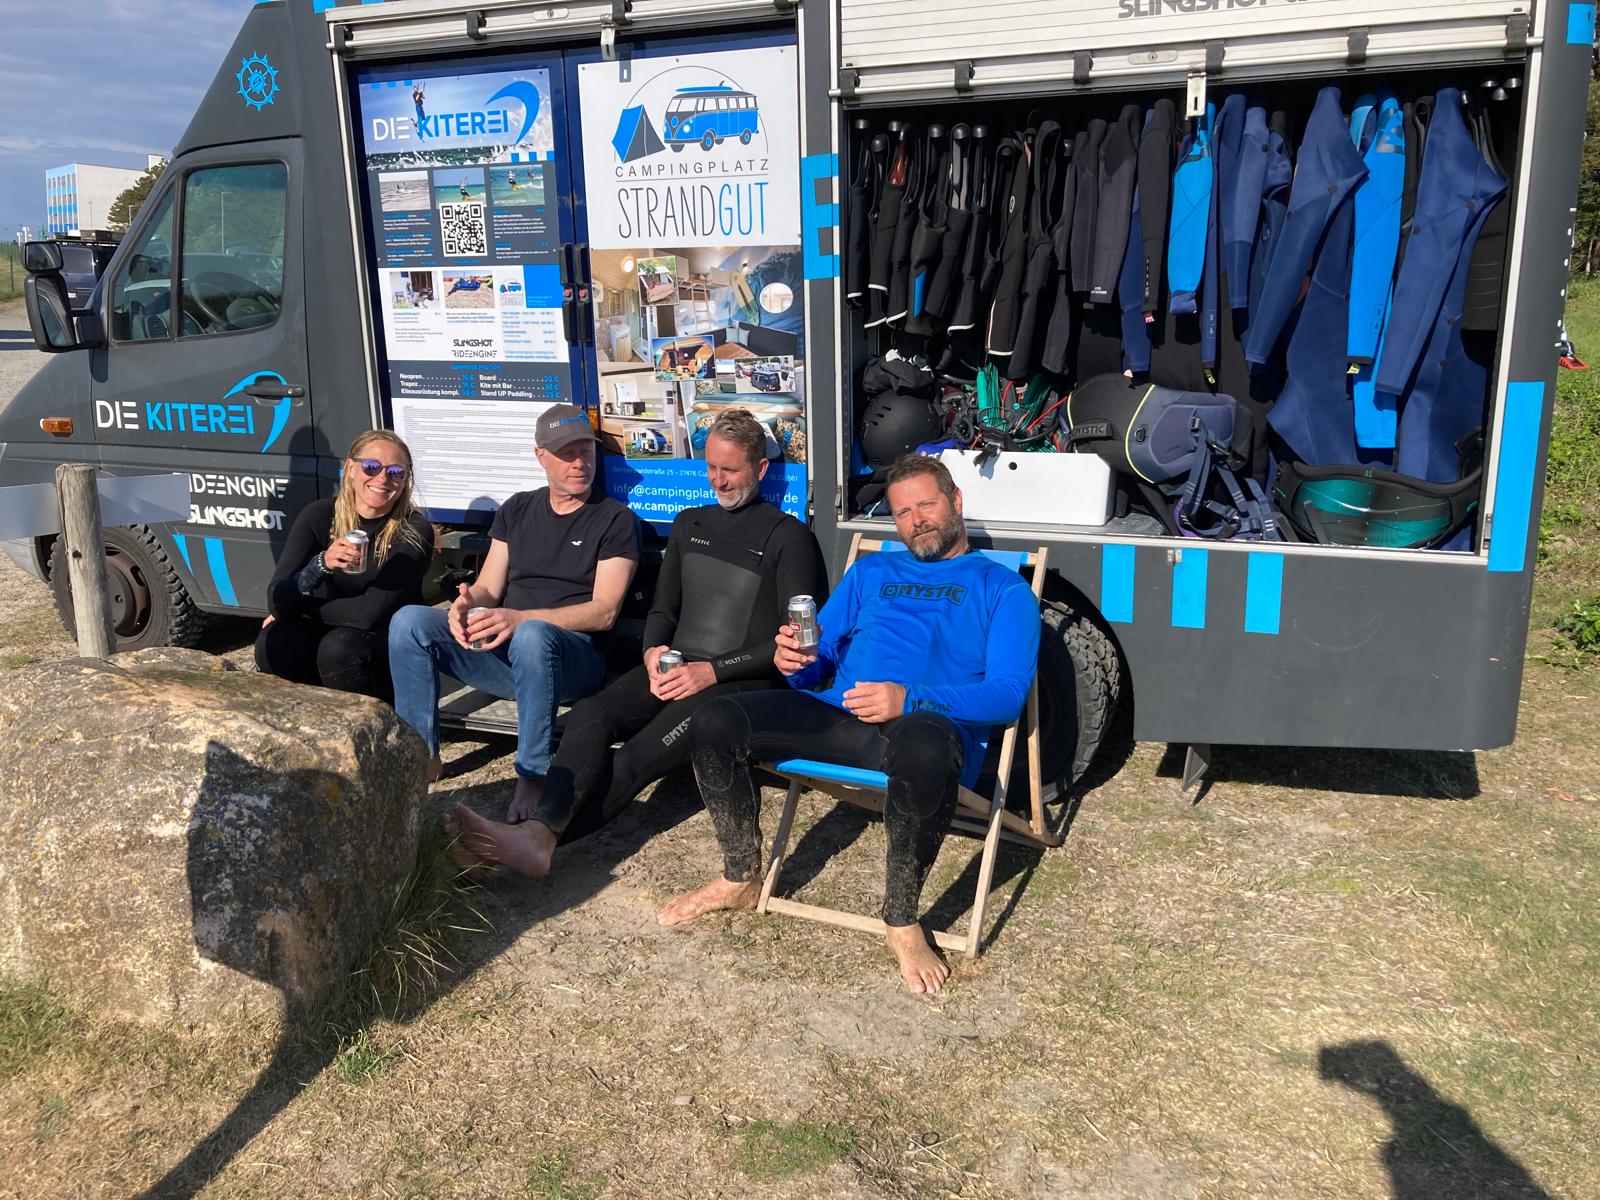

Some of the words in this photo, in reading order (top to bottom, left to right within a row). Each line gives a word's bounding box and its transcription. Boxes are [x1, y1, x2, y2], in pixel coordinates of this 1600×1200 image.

[372, 117, 410, 141] DIE
[416, 109, 509, 139] KITEREI
[615, 158, 769, 178] CAMPINGPLATZ
[617, 182, 769, 239] STRANDGUT
[453, 339, 494, 347] SLINGSHOT
[400, 373, 423, 381] Neopren
[401, 389, 440, 397] Kiteausrüstung
[507, 391, 533, 399] Paddling
[95, 400, 140, 430] DIE
[145, 402, 255, 434] KITEREI
[173, 472, 289, 499] IDEENGINE
[187, 504, 287, 531] SLINGSHOT
[897, 584, 965, 604] MYSTIC
